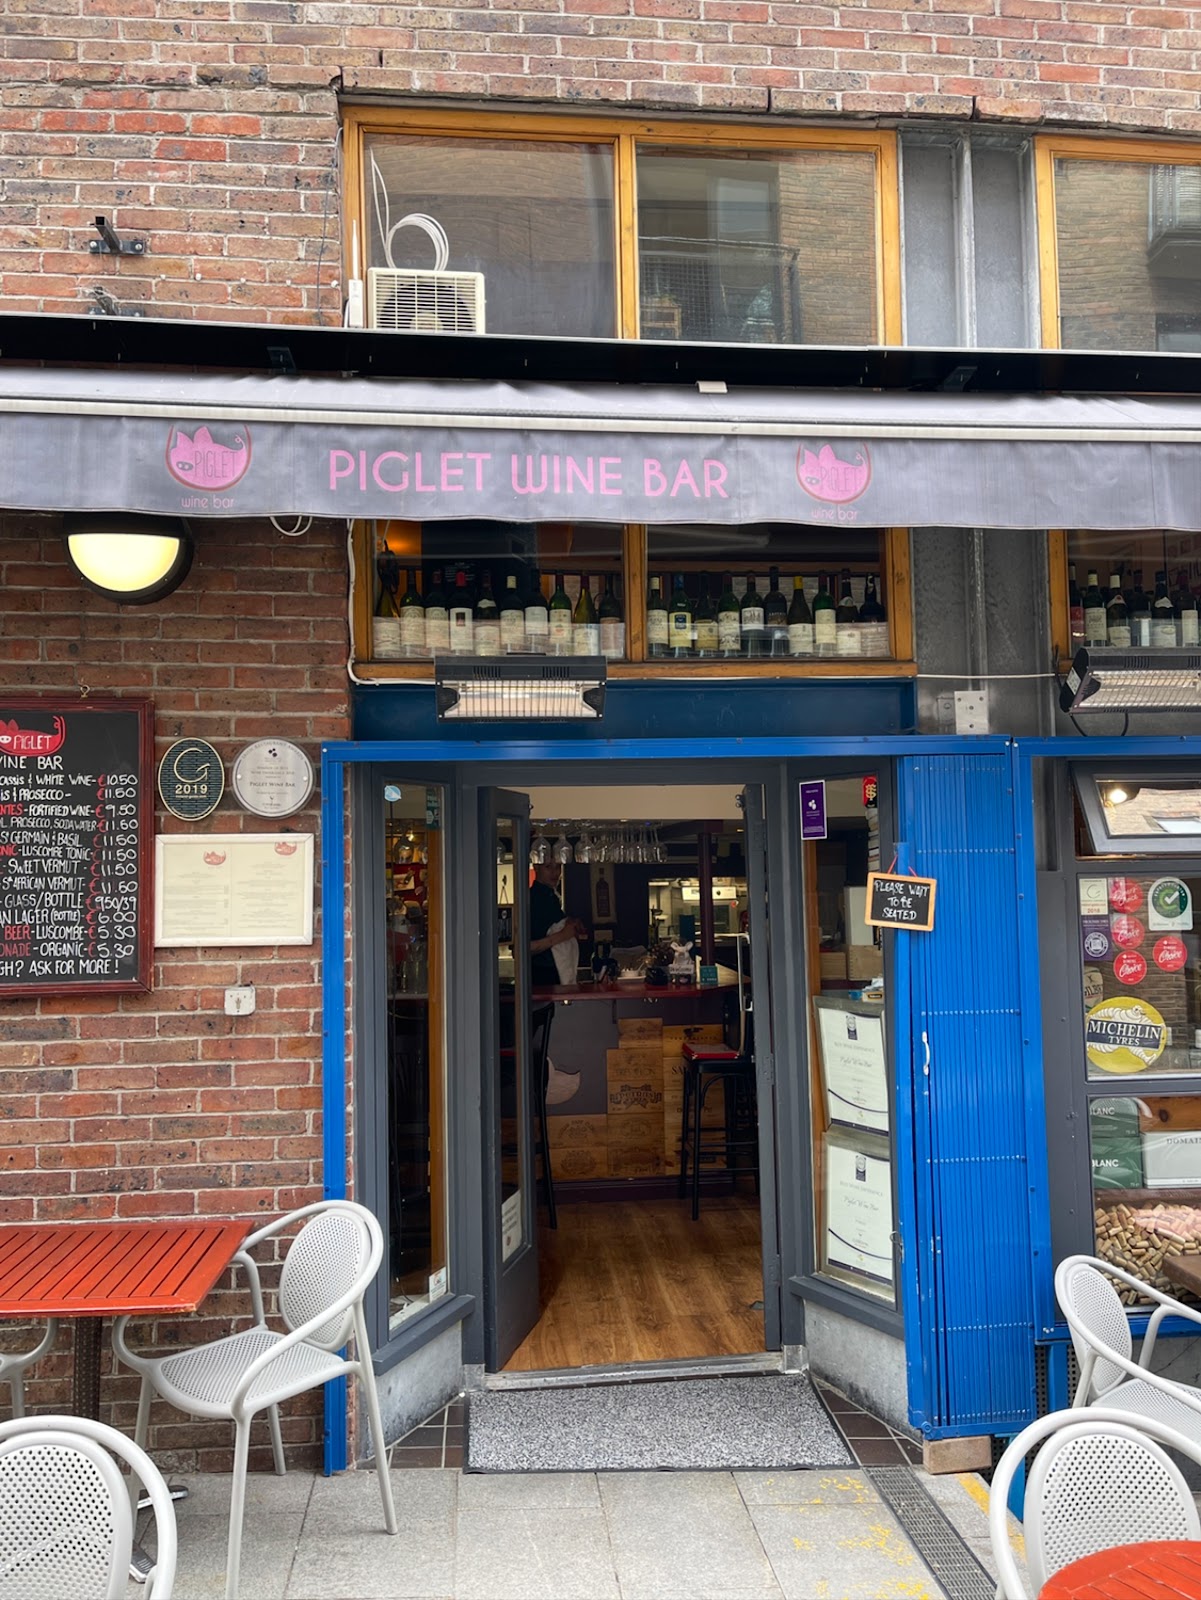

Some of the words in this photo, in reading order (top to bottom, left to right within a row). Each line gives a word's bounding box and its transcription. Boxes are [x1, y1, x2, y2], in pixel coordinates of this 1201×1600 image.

[194, 450, 238, 479] PIGLET
[329, 449, 492, 492] PIGLET
[510, 454, 623, 495] WINE
[643, 458, 729, 498] BAR
[819, 466, 862, 492] PGLET
[181, 496, 208, 509] wine
[212, 494, 235, 509] bar
[837, 505, 859, 520] bar
[13, 734, 52, 750] PIGLET
[37, 755, 63, 770] BAR
[36, 773, 65, 786] WHITE
[175, 784, 208, 795] 2019
[95, 803, 136, 818] €9.50
[10, 830, 50, 846] GERMAIN
[57, 832, 83, 848] BASIL
[22, 845, 63, 858] LUSCOMBE
[8, 858, 40, 874] SWEET
[41, 859, 81, 875] VERMUT
[13, 876, 46, 892] AFRICAN
[874, 879, 905, 895] PLEASE
[908, 884, 931, 898] WAIT
[4, 892, 84, 909] GLASS/BOTTLE
[887, 896, 900, 907] TO
[900, 896, 913, 908] BE
[14, 909, 50, 926] LAGER
[85, 910, 137, 926] €6.00
[882, 907, 917, 921] SEATED
[87, 925, 136, 940] €5.30
[87, 941, 135, 959] €5.30
[1159, 949, 1182, 963] Choice
[29, 959, 52, 976] ASK
[55, 959, 75, 975] FOR
[80, 959, 111, 975] MORE
[1119, 963, 1142, 977] Choice
[1089, 1020, 1162, 1039] MICHELIN
[1107, 1035, 1140, 1047] TYRES
